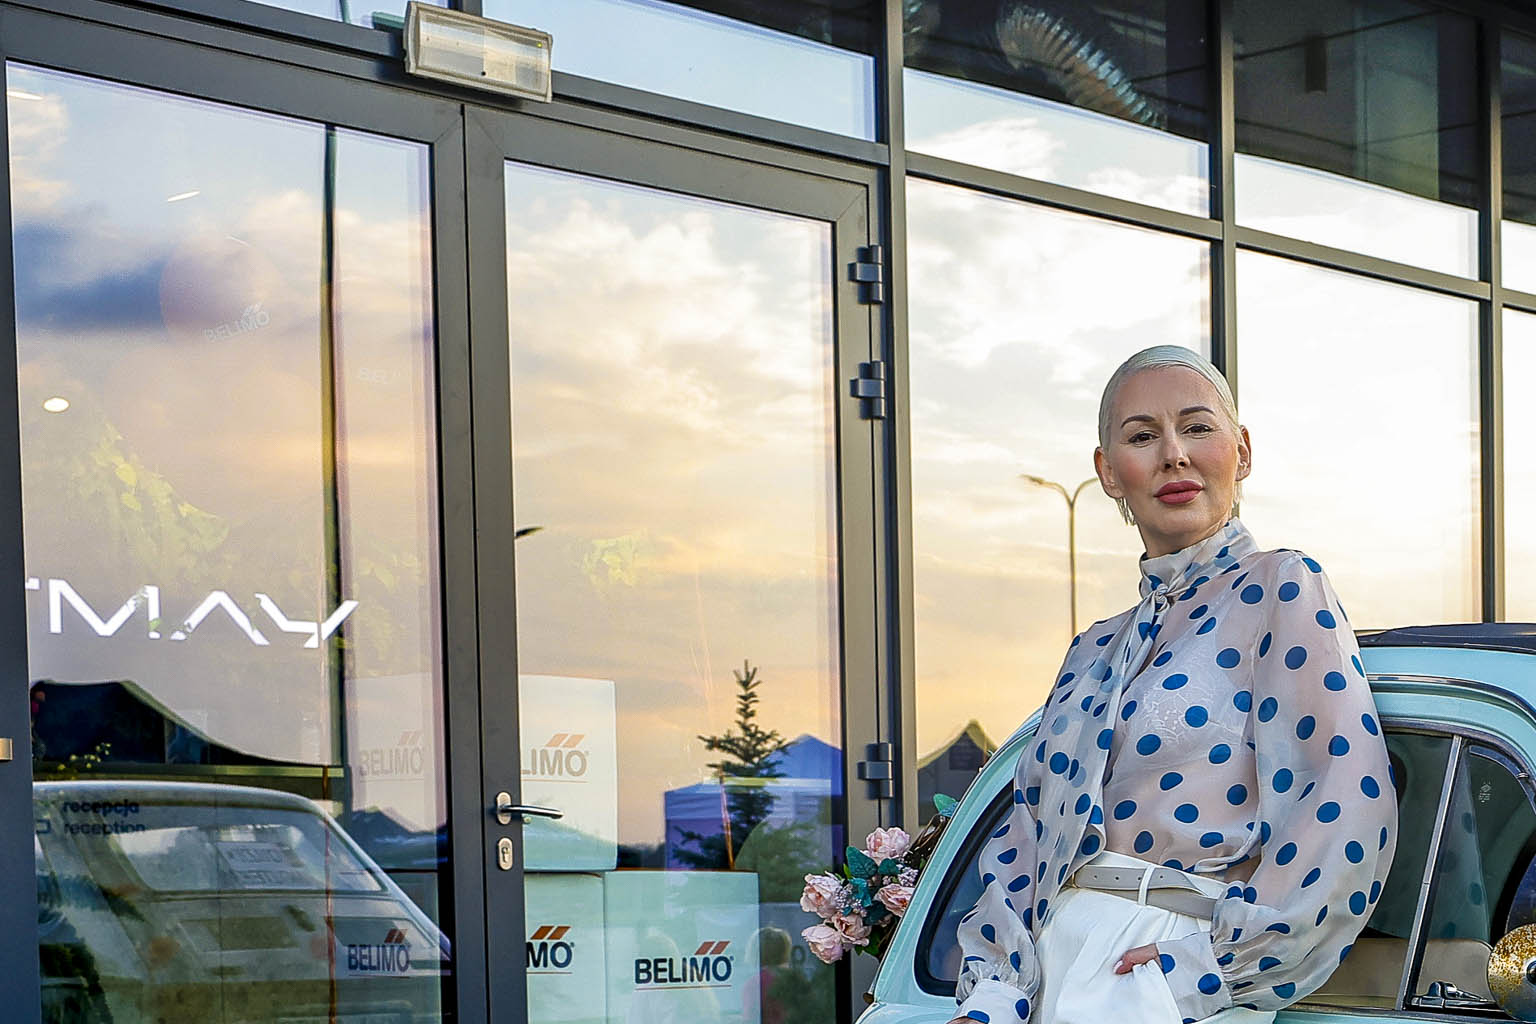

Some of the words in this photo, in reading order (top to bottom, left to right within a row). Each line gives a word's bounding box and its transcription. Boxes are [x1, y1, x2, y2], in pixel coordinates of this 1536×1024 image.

[358, 749, 424, 777] BELIMO
[347, 942, 411, 973] BELIMO
[634, 955, 733, 984] BELIMO
